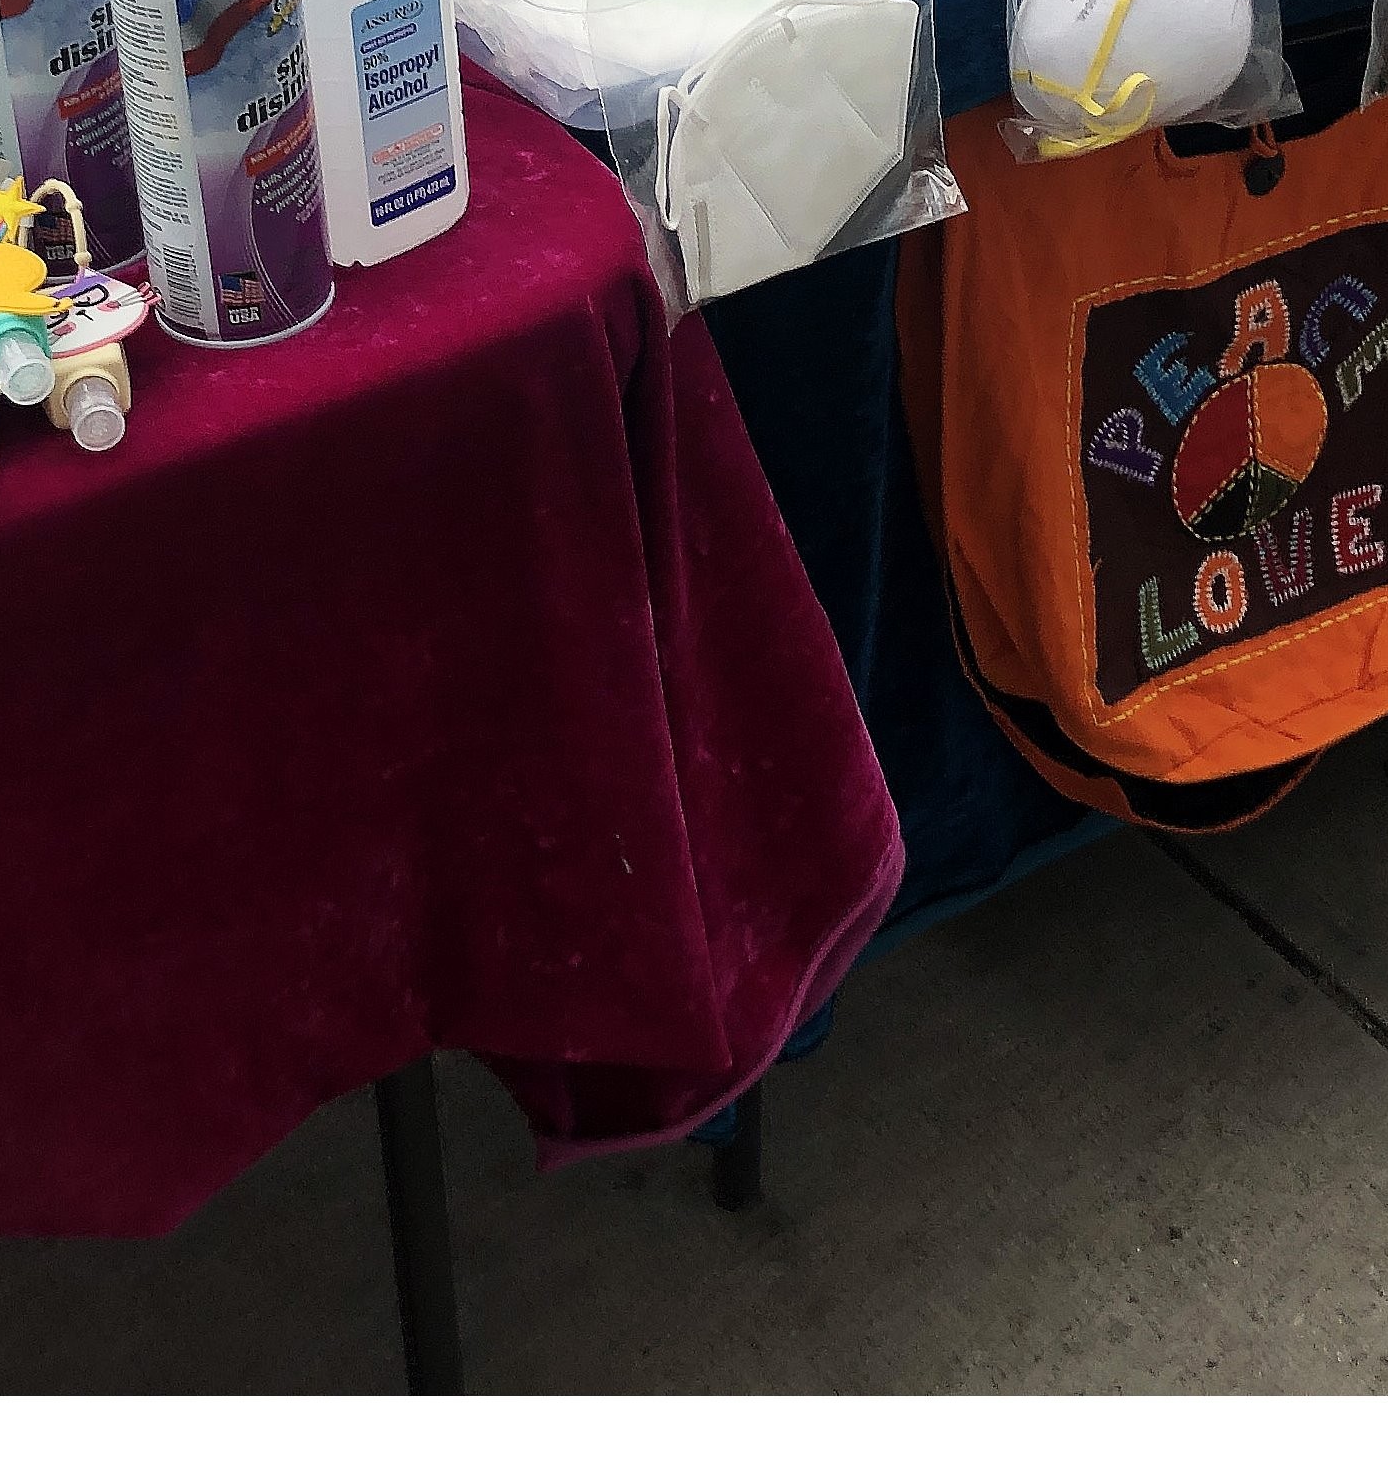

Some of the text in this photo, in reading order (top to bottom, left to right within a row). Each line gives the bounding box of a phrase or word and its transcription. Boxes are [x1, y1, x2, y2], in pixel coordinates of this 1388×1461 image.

[362, 50, 390, 71] 50%
[364, 43, 440, 91] Isopropyl
[368, 72, 429, 114] Alcohol
[228, 309, 261, 324] USA
[1137, 482, 1385, 670] LOVE
